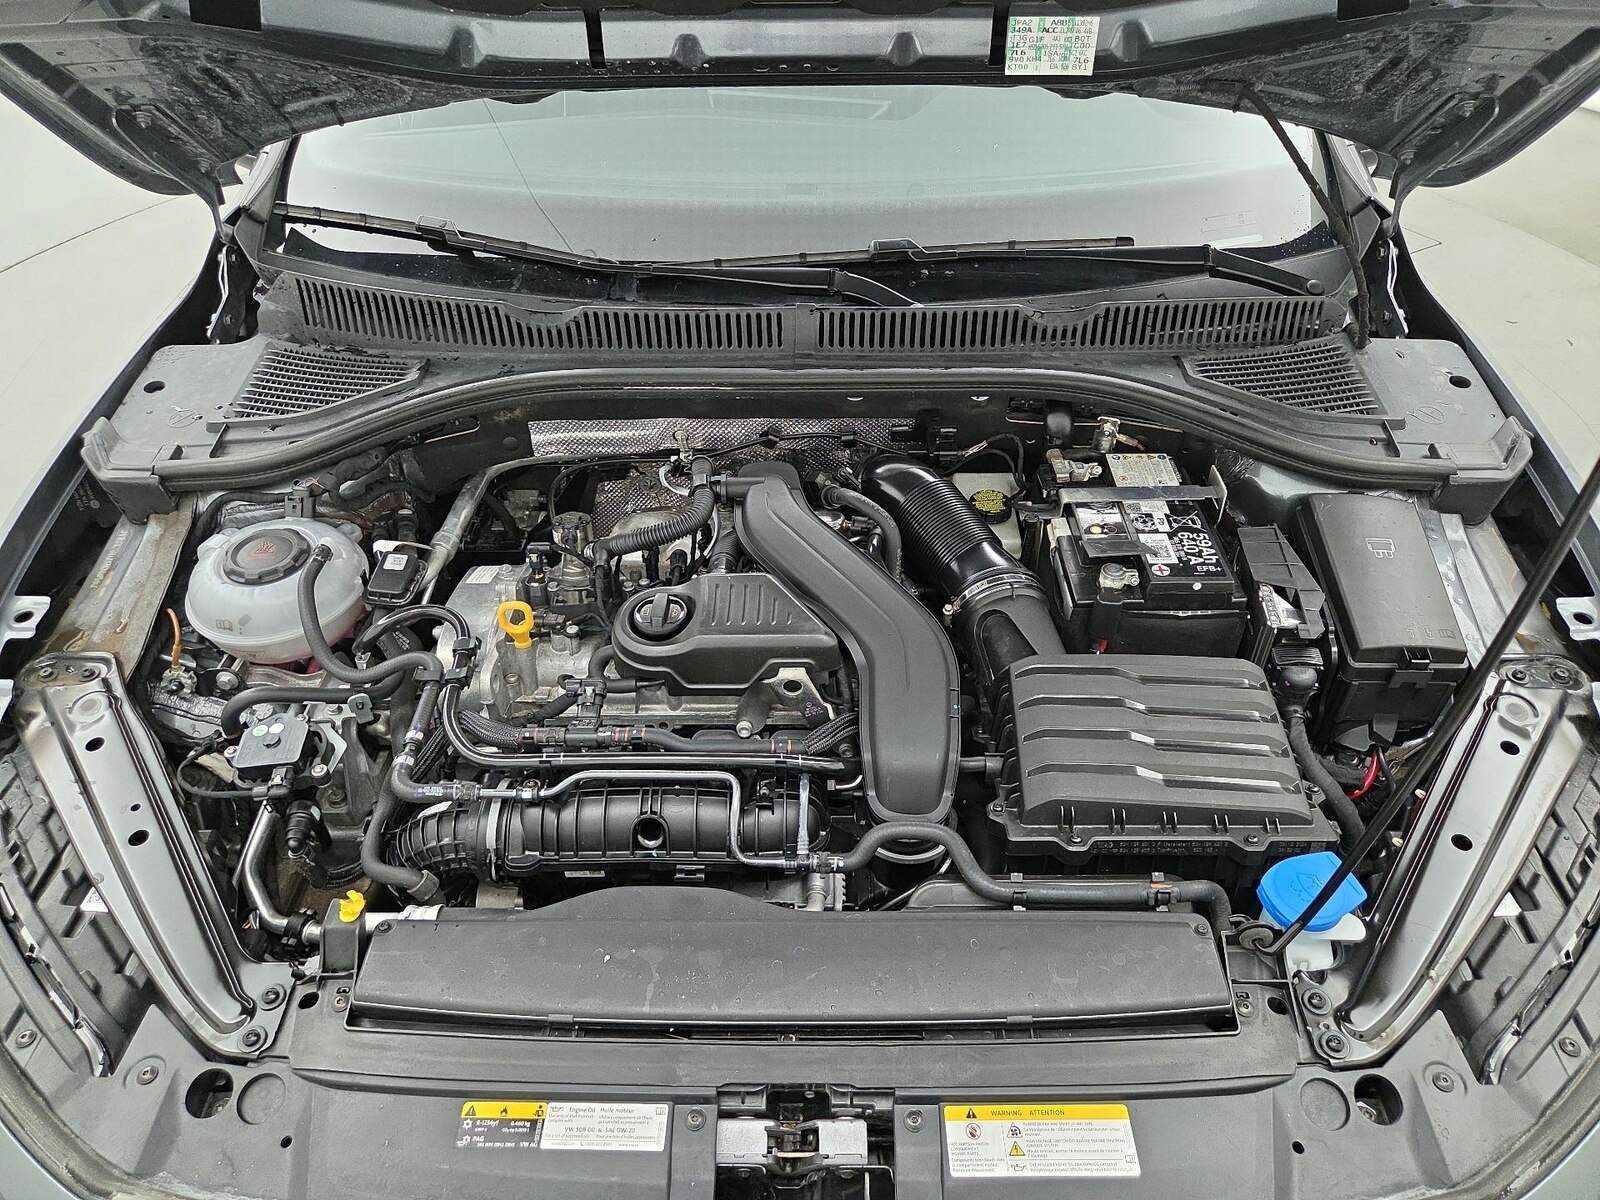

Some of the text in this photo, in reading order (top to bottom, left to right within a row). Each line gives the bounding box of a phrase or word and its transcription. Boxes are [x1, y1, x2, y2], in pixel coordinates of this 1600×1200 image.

[1178, 532, 1199, 552] 640
[1193, 533, 1218, 563] 59Ah
[1187, 556, 1204, 564] A
